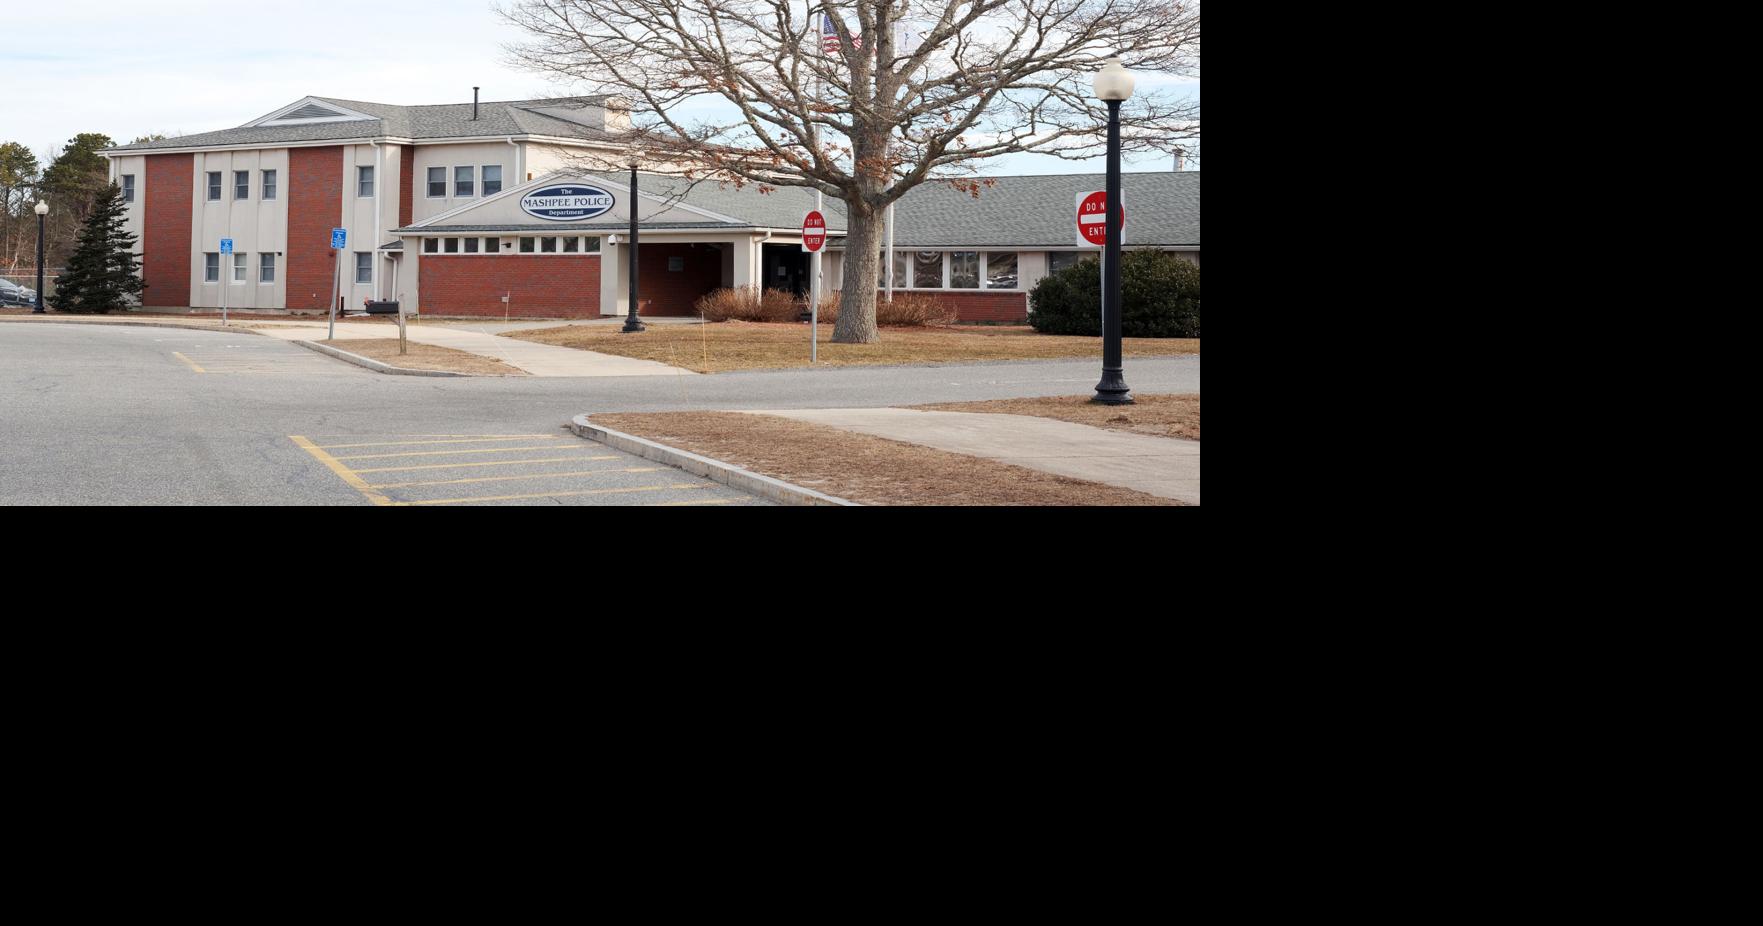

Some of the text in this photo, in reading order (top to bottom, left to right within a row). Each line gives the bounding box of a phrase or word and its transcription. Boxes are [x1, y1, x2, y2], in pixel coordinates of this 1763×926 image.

[523, 197, 611, 208] MASHPEE POLICE
[1086, 202, 1097, 212] DO
[548, 209, 584, 217] Department
[807, 218, 813, 226] DO
[1089, 226, 1107, 236] ENT
[807, 237, 820, 245] ENTER
